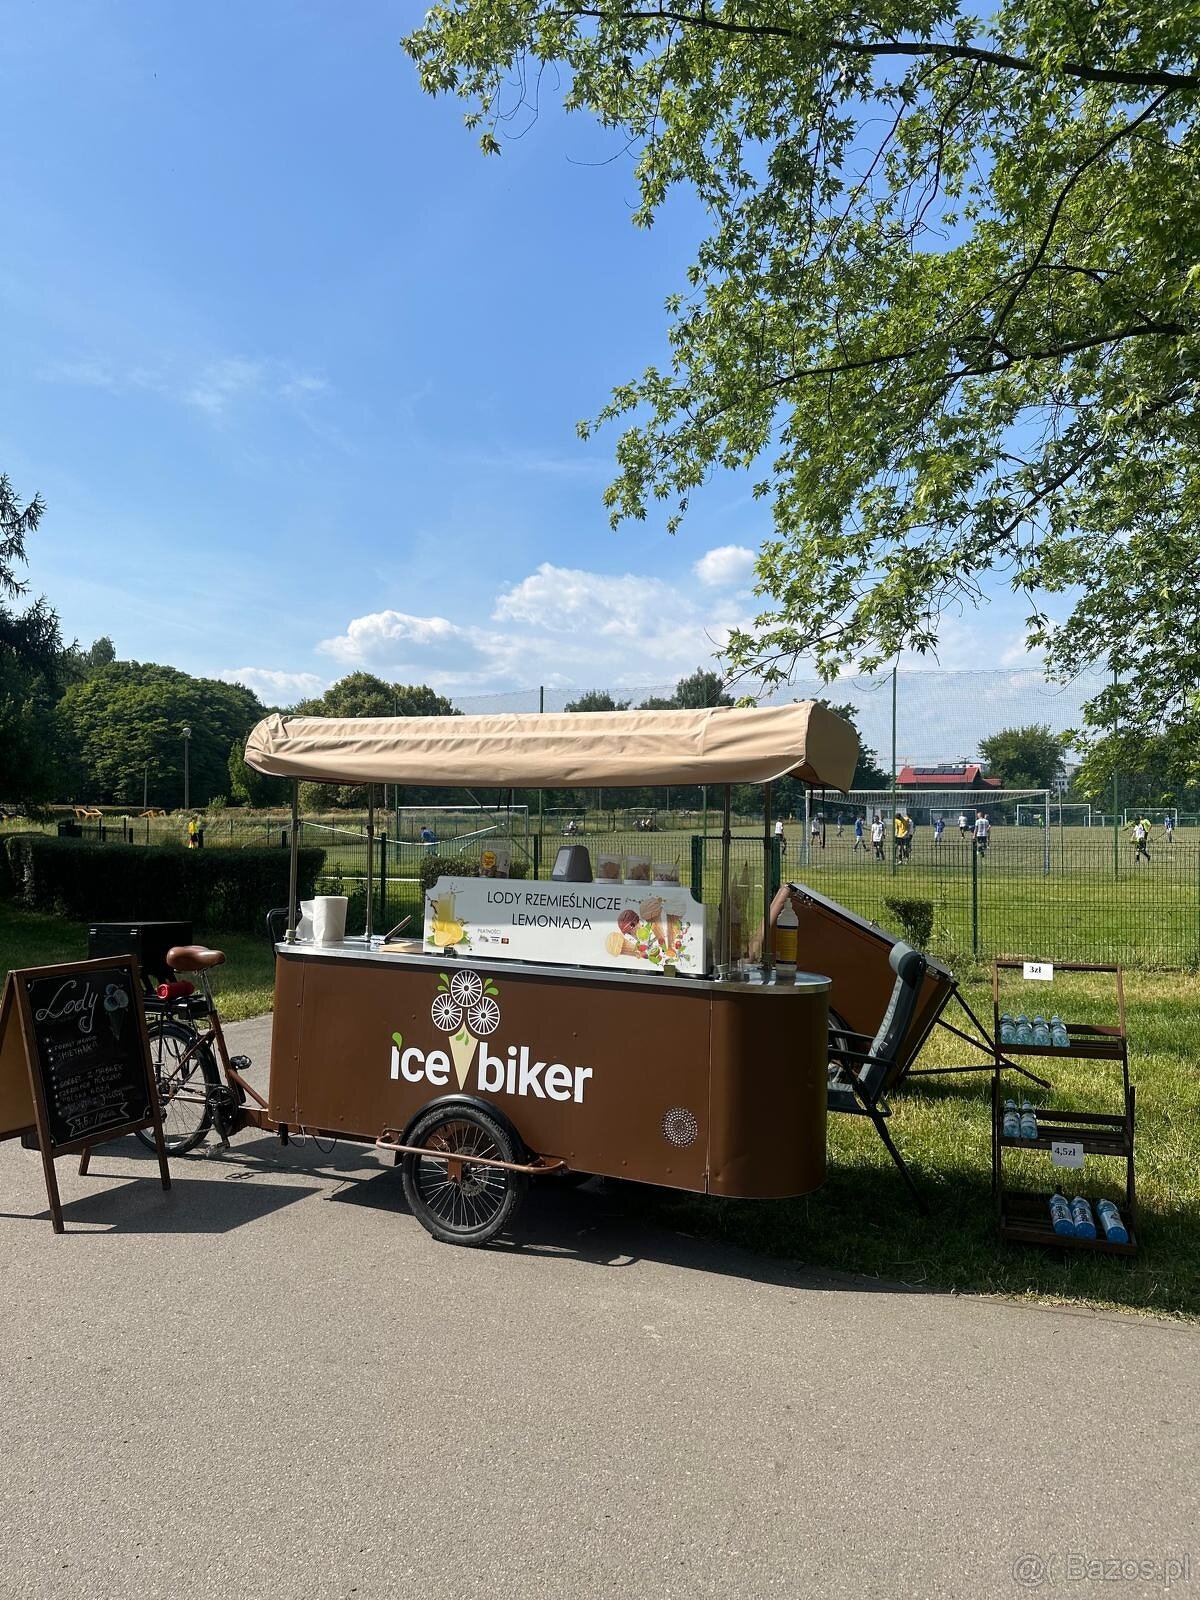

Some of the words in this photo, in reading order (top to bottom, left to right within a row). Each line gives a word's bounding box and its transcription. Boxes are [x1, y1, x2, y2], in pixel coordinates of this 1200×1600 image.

[487, 890, 522, 906] LODY
[525, 892, 622, 911] RZEMIEŚLNICZE
[512, 913, 592, 931] LEMONIADA
[35, 980, 99, 1034] Lody
[390, 1031, 450, 1086] ice
[477, 1041, 593, 1103] biker
